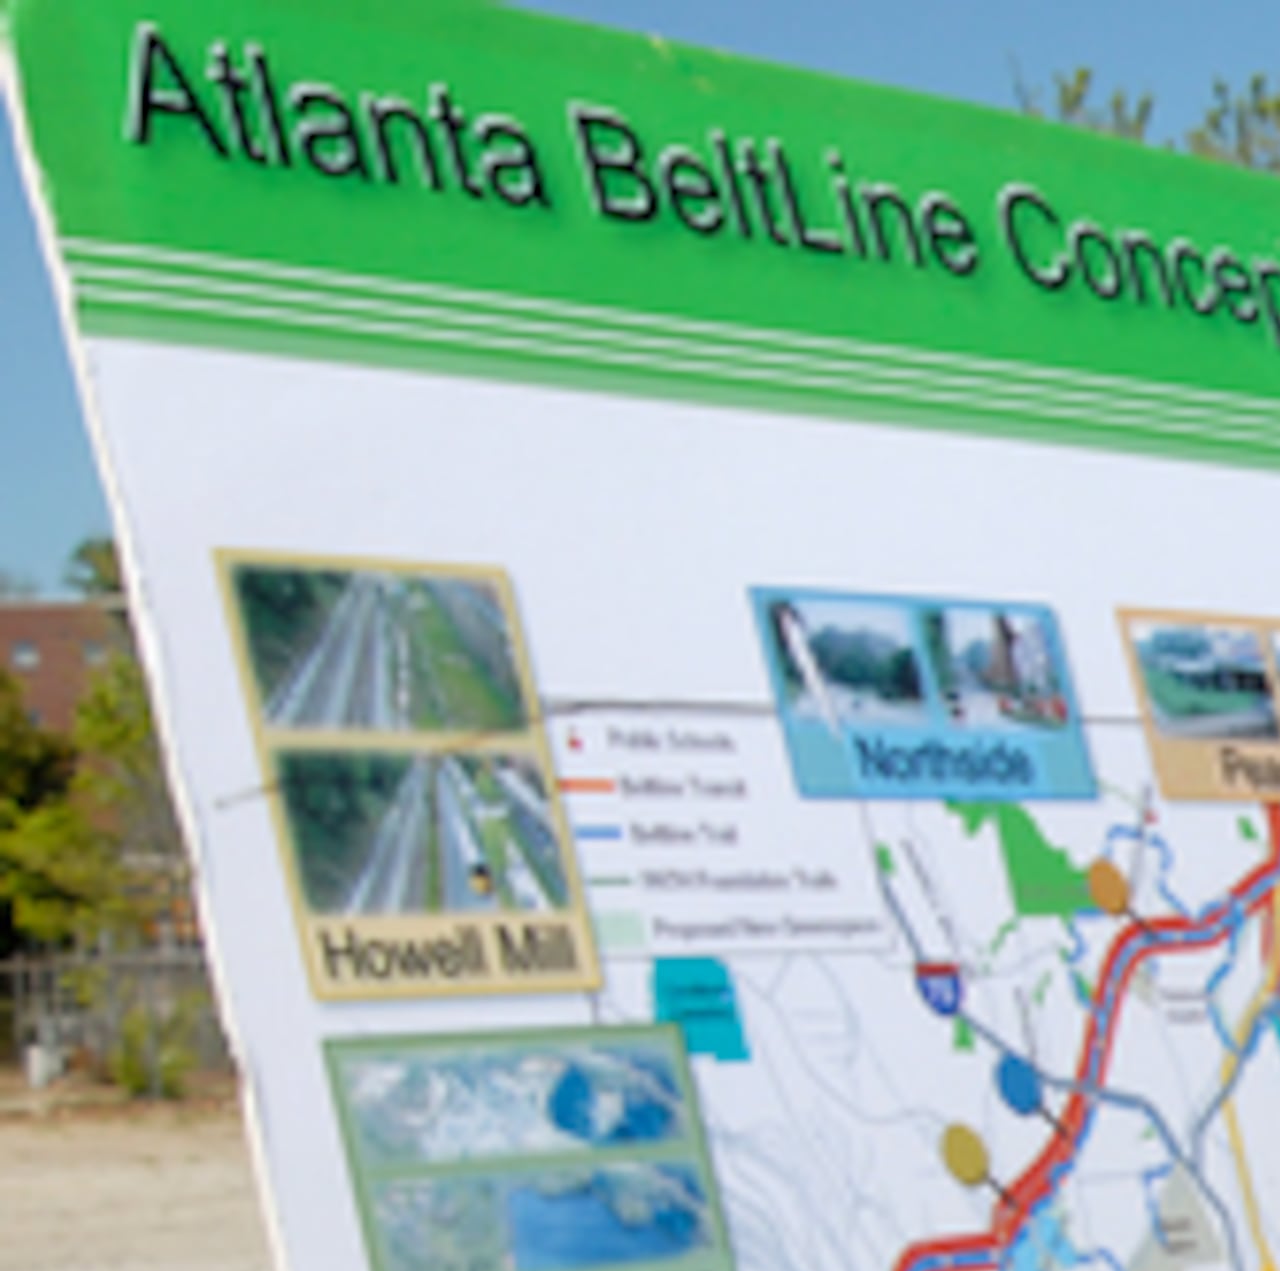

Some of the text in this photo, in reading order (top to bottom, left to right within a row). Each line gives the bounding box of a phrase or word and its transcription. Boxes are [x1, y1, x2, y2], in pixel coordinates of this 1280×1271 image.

[125, 22, 552, 209] Atlanta
[568, 100, 977, 276] BeltLine
[854, 738, 1036, 785] Northside
[318, 922, 578, 980] Howell Mill
